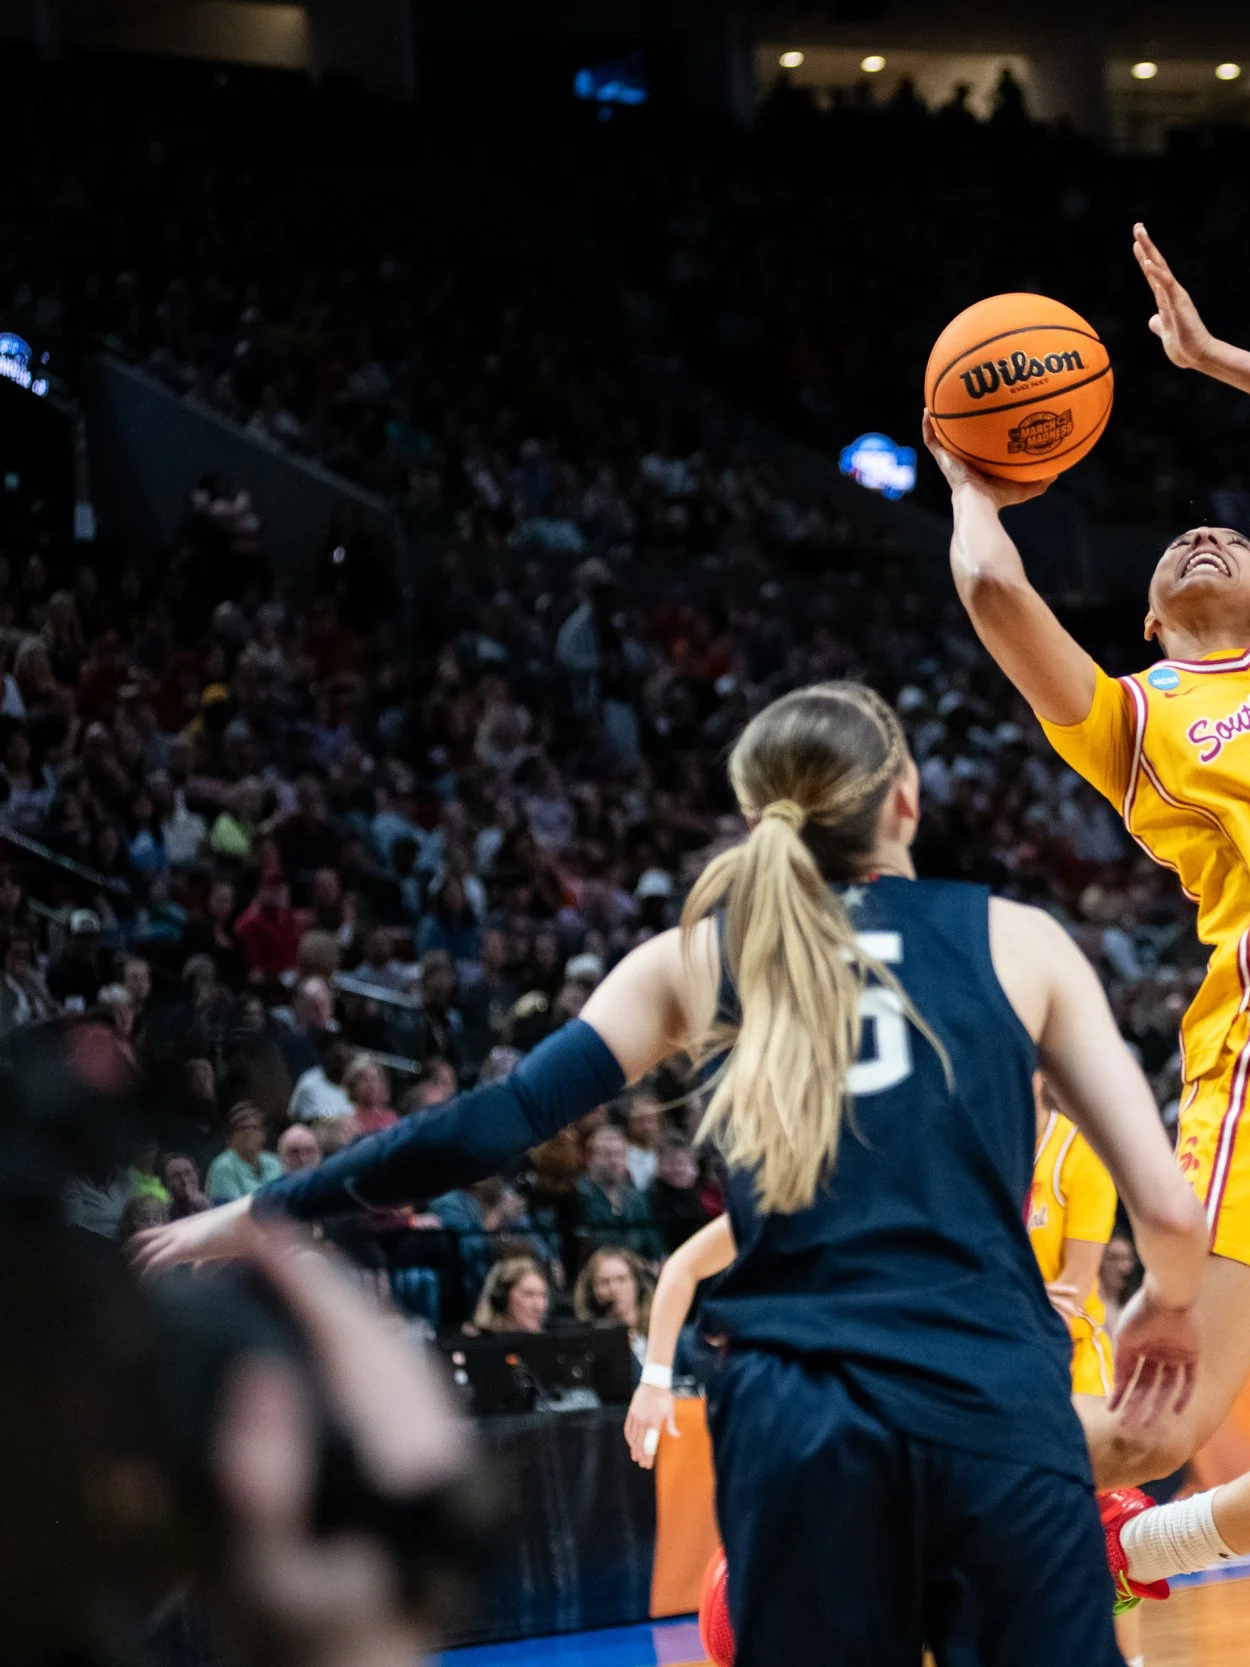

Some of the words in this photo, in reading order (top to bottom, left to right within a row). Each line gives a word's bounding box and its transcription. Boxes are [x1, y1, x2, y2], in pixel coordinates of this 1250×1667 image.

[958, 350, 1086, 400] Wilson
[1020, 417, 1057, 439] MARCH
[1026, 420, 1074, 448] MADNESS
[838, 931, 914, 1096] 5
